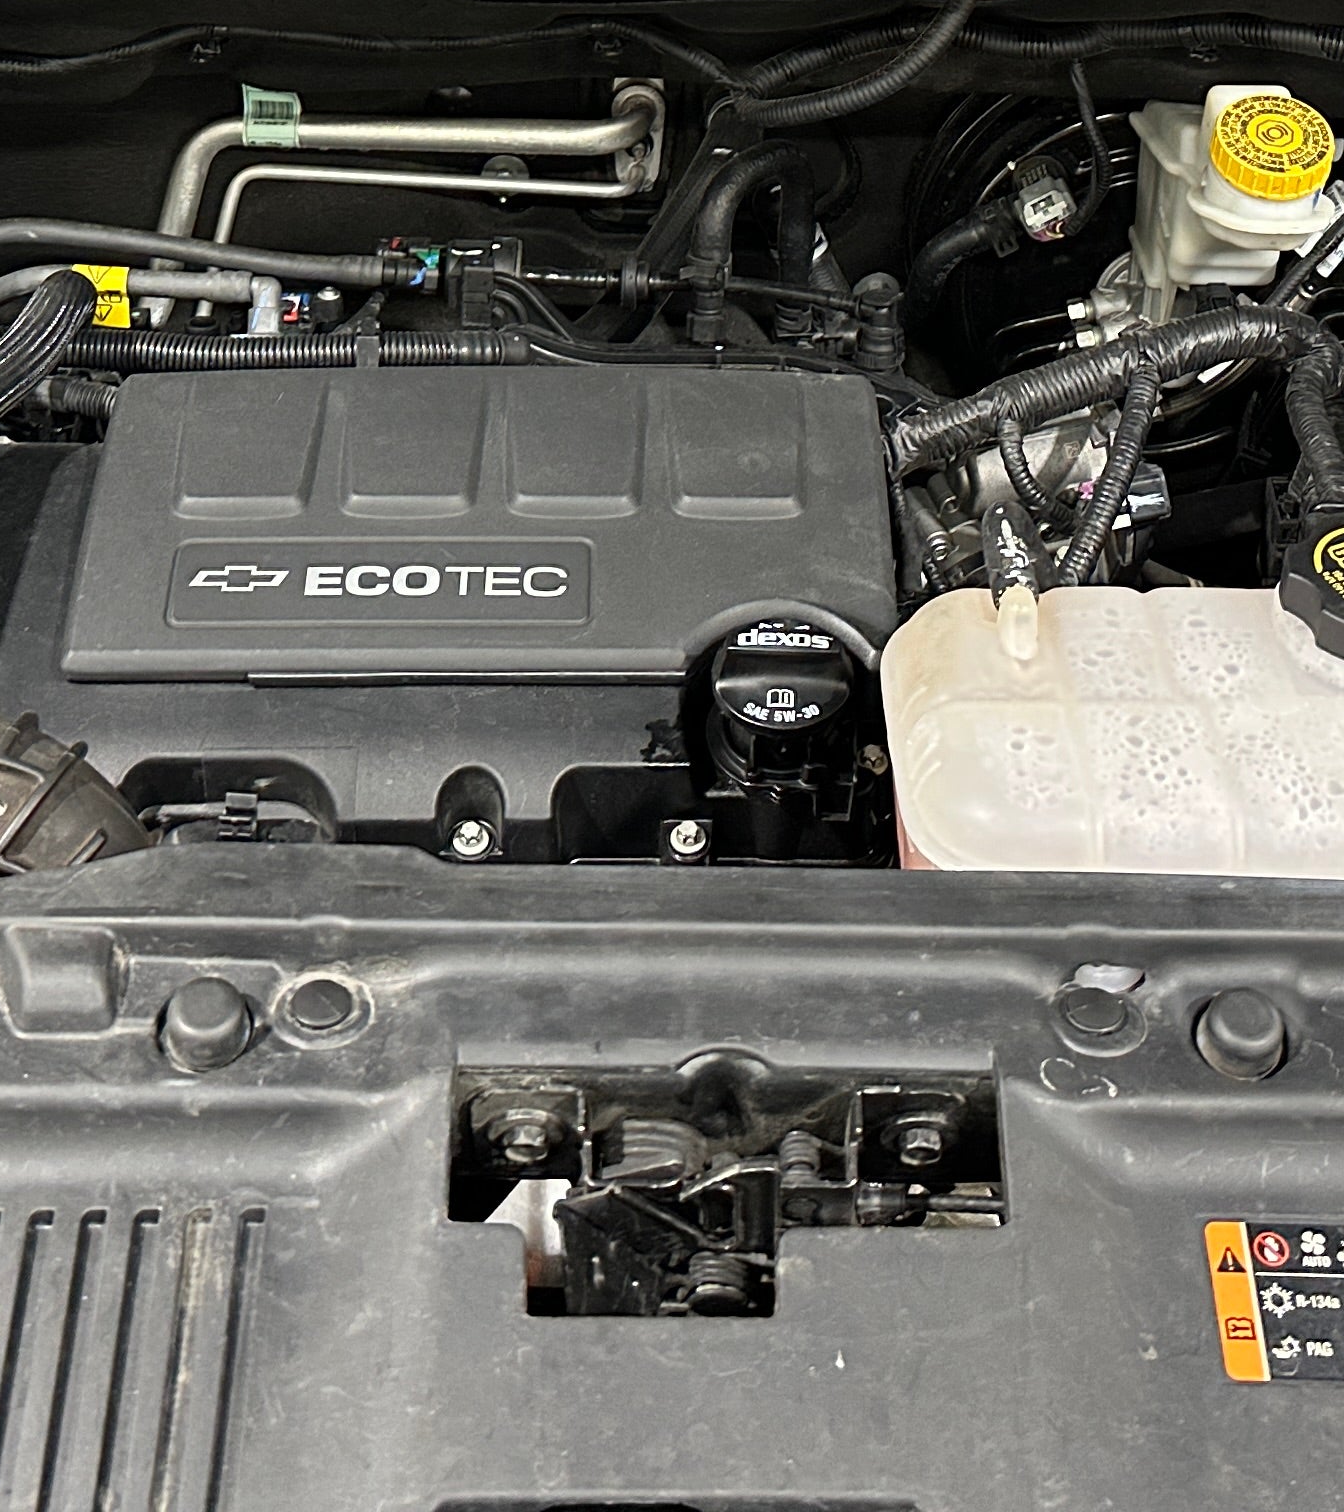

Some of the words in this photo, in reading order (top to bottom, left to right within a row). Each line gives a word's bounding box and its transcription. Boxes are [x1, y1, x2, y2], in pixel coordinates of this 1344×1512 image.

[304, 565, 568, 597] ECOTEC
[737, 628, 831, 649] dexos
[743, 702, 770, 721] SAE
[773, 704, 820, 723] 5W-30
[1302, 1256, 1332, 1268] AUTO
[1295, 1294, 1341, 1309] R-134a
[1306, 1341, 1335, 1357] PAG
